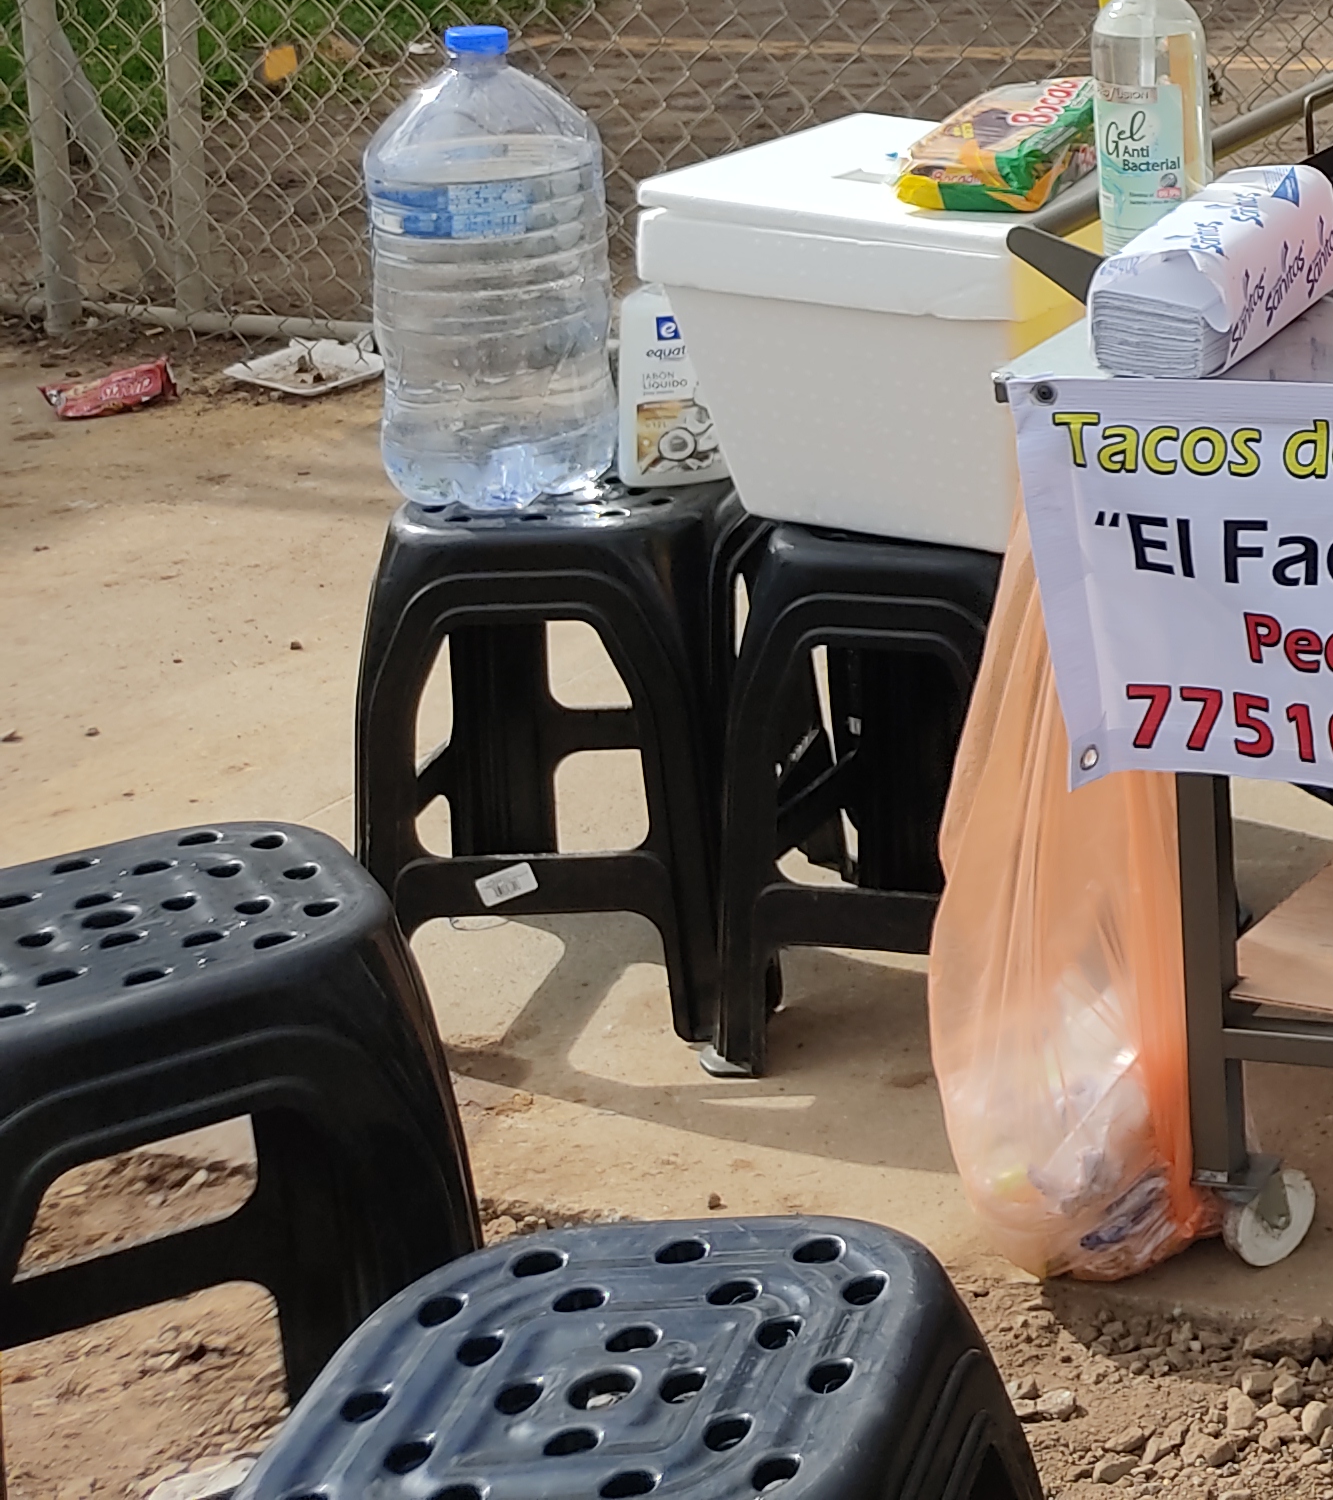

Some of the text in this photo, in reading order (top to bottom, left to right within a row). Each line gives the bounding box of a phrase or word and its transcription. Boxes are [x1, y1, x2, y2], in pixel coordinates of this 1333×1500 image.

[1105, 110, 1146, 158] Gel
[1123, 145, 1150, 158] Anti
[1122, 156, 1181, 172] Bacterial
[645, 344, 687, 360] equat
[1052, 410, 1262, 478] Tacos
